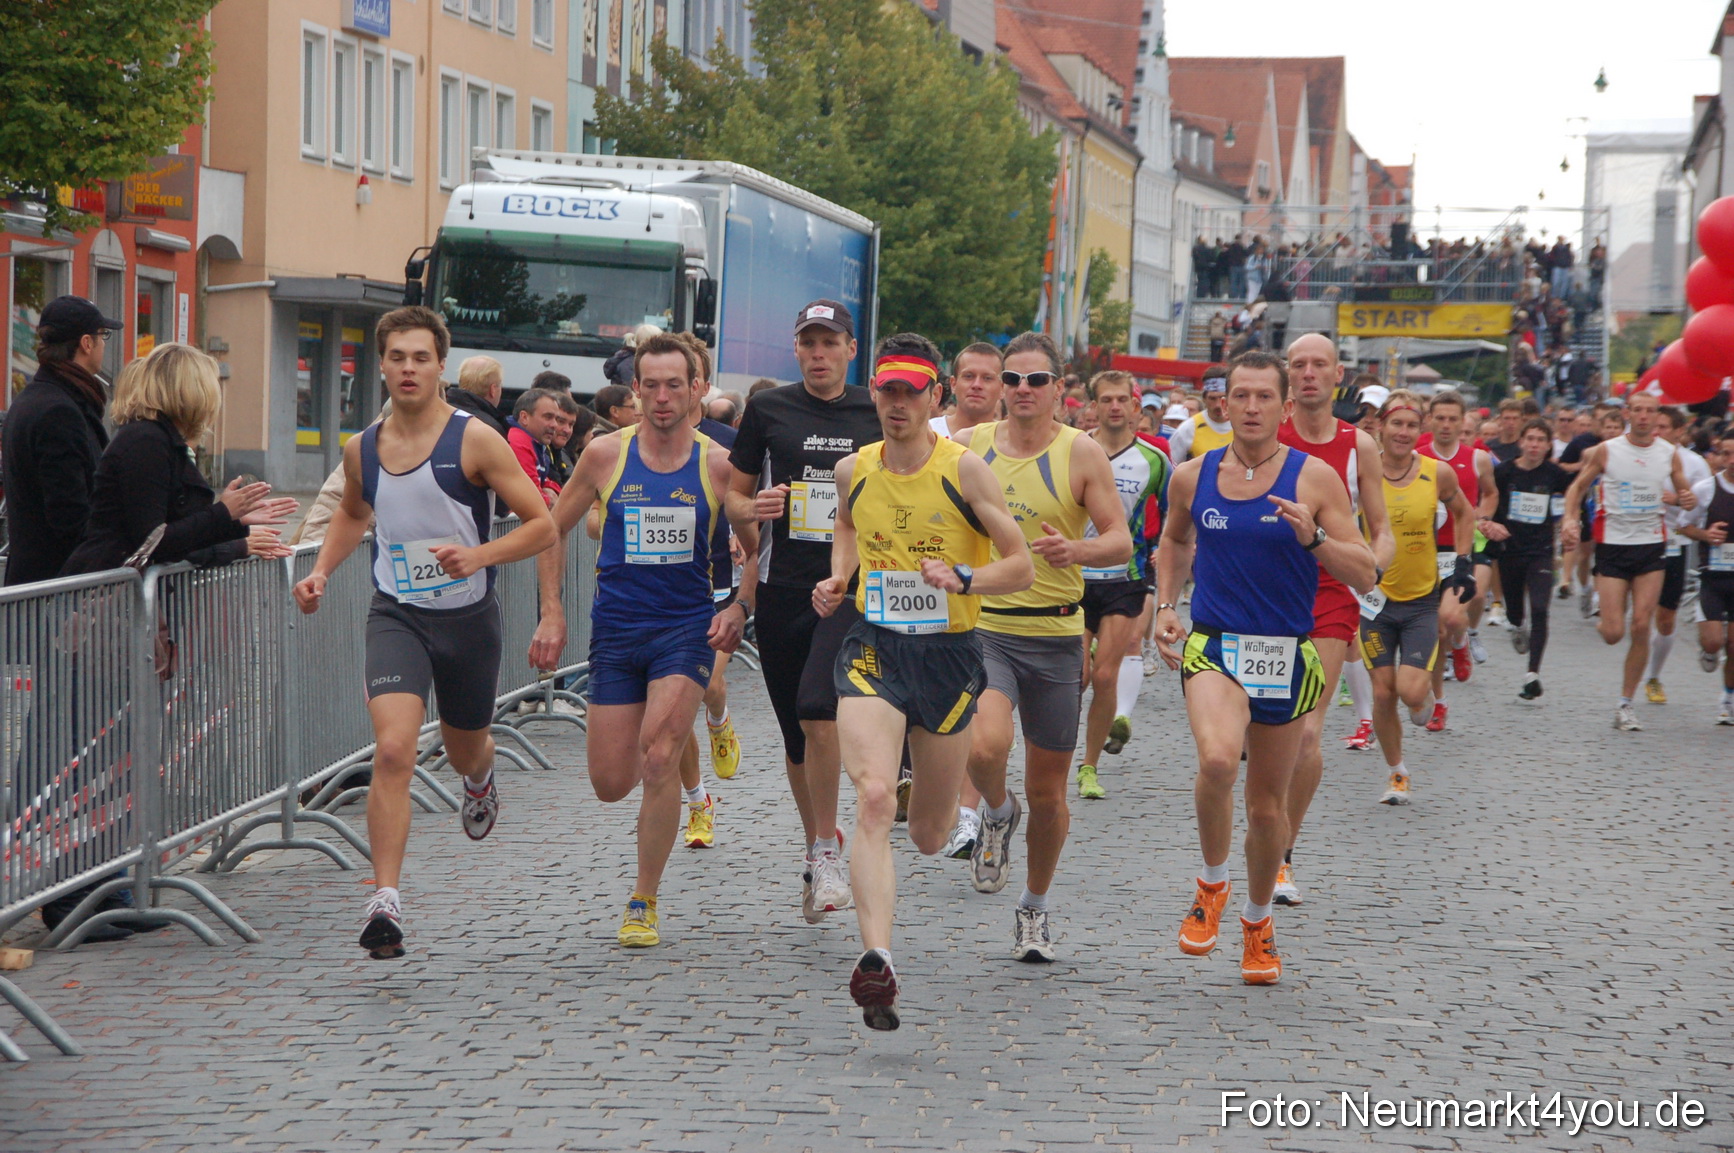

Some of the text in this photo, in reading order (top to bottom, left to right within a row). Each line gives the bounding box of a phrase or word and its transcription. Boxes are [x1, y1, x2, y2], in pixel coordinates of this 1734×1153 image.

[136, 183, 160, 193] DER
[136, 193, 183, 207] BÄCKER
[502, 194, 621, 220] BOCK
[1353, 309, 1433, 328] START
[828, 437, 853, 447] SPORT
[803, 465, 835, 478] Power
[623, 484, 642, 492] UBH
[810, 488, 836, 499] Artur
[793, 504, 798, 512] A
[1005, 501, 1039, 518] erhof
[644, 512, 675, 523] Helmut
[646, 529, 688, 544] 3355
[869, 559, 897, 568] M & S
[441, 582, 469, 592] PFLEIDERER
[886, 577, 916, 588] Marco
[870, 594, 937, 612] A 2000
[1244, 641, 1284, 656] Wolfgang
[1244, 659, 1286, 676] 2612
[371, 675, 401, 687] ODLO
